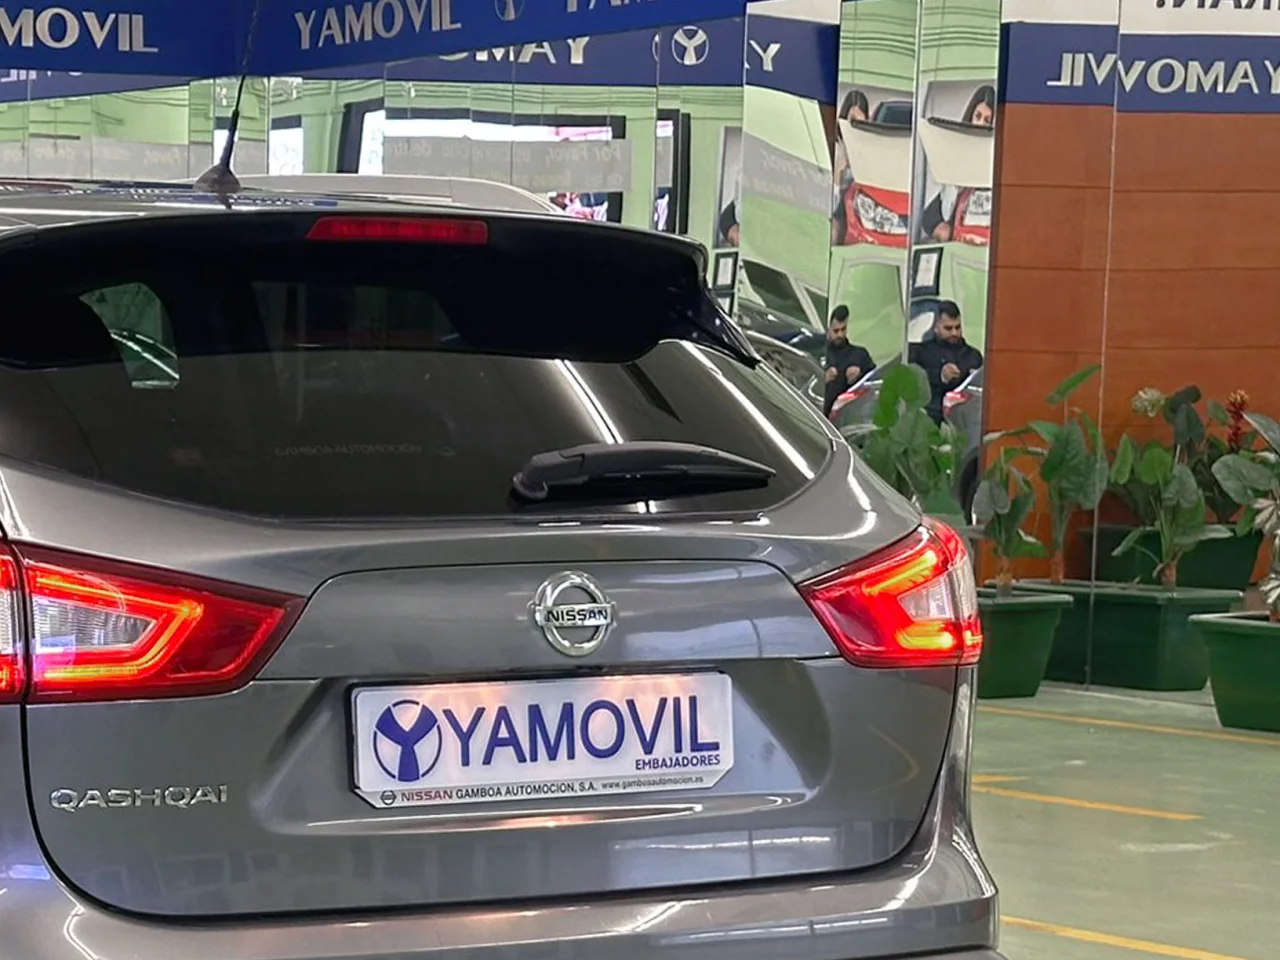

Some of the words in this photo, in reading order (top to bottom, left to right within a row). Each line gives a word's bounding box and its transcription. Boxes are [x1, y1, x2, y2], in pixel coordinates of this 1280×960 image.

[294, 0, 462, 50] YAMOVIL
[545, 608, 608, 623] NISSAN
[442, 695, 720, 767] YAMOVIL
[635, 754, 721, 770] EMBAJADORES
[50, 785, 227, 812] QASHQAI
[401, 789, 452, 802] NISSAN
[456, 786, 502, 799] GAMBOA
[505, 783, 578, 798] AUTOMOCION,
[579, 781, 597, 792] S.A.
